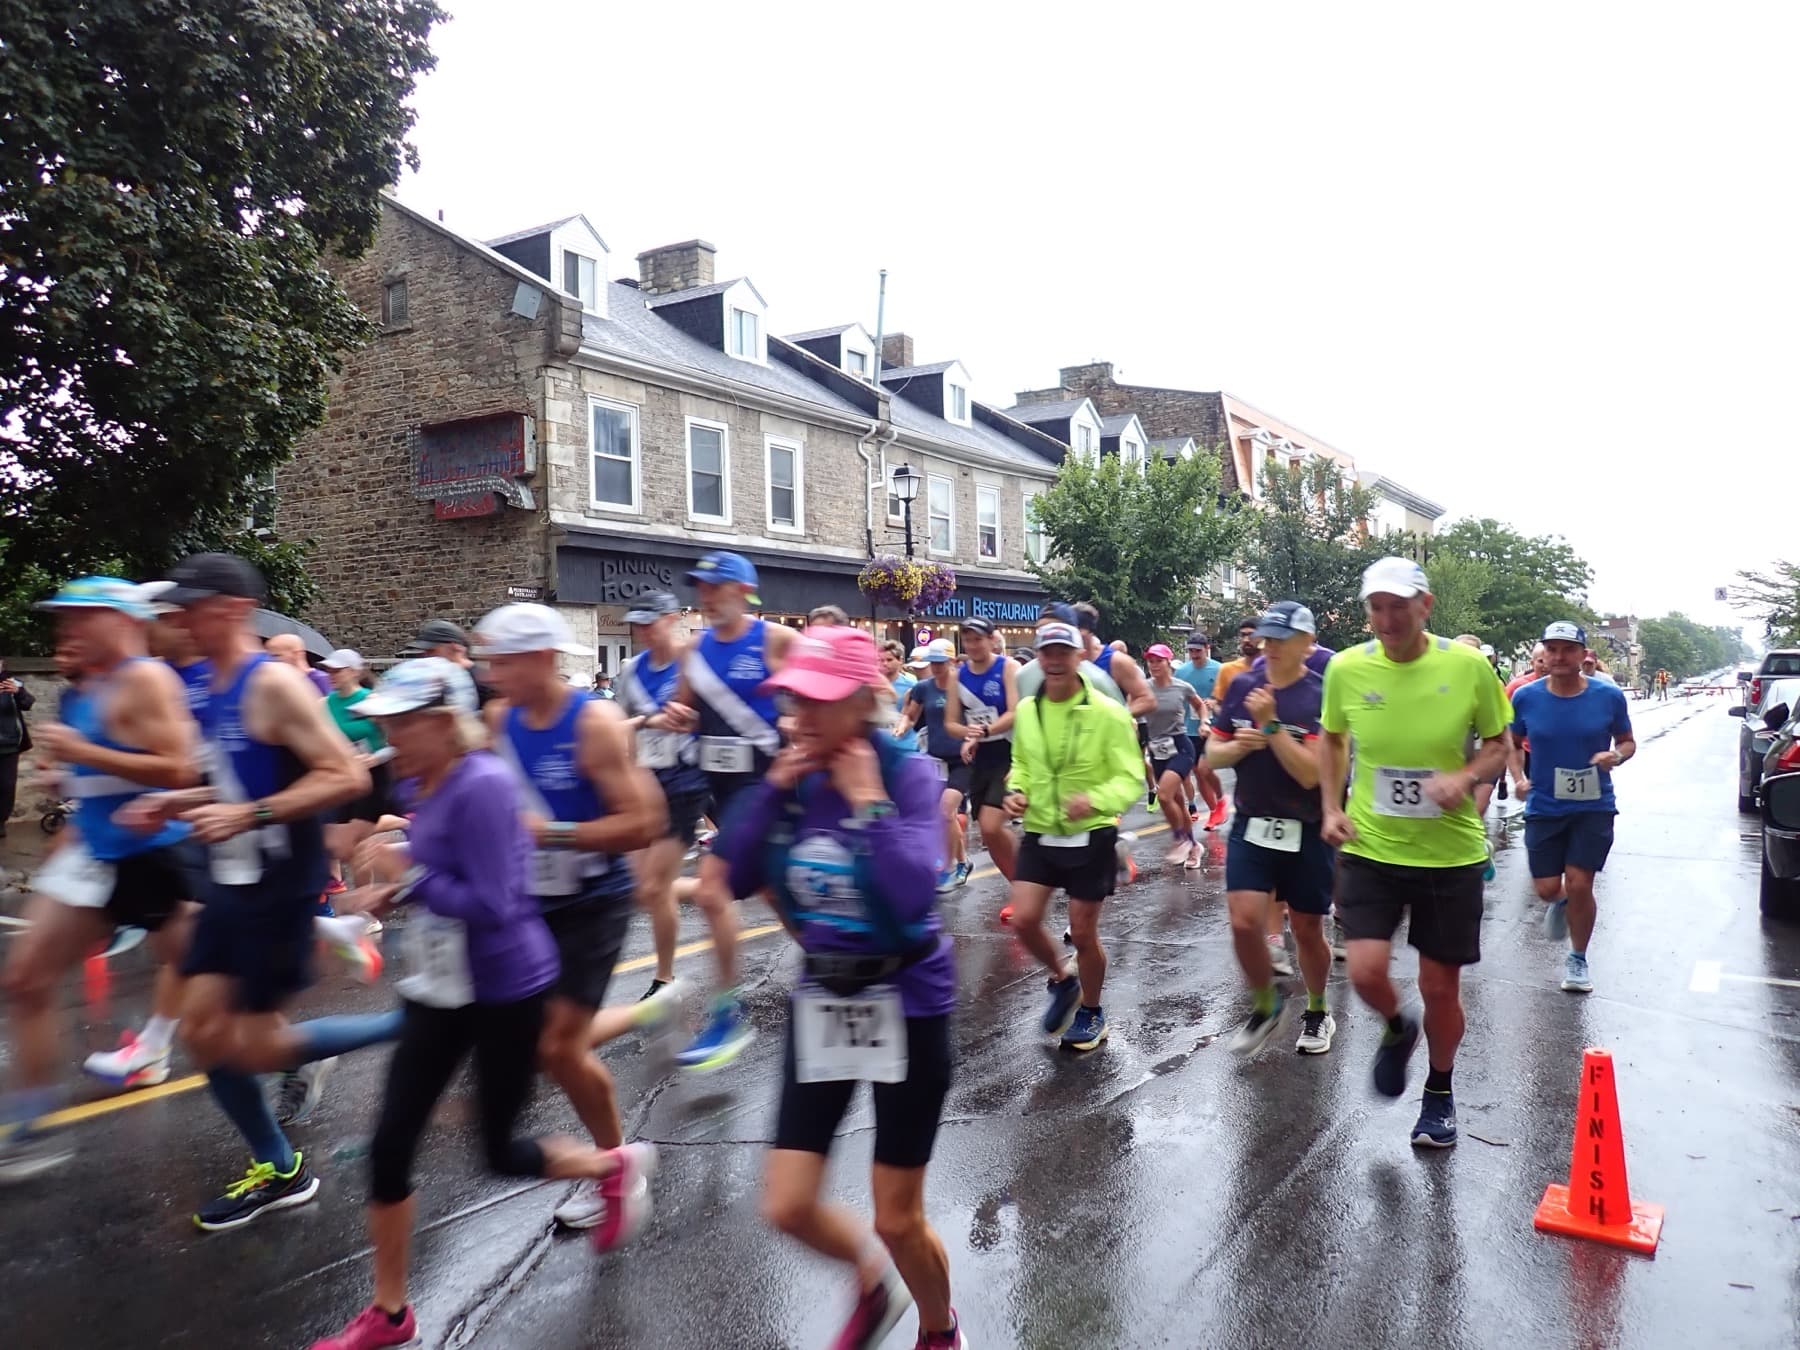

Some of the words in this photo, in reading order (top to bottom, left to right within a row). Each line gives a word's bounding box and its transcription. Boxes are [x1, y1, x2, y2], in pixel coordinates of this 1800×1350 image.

[601, 559, 673, 587] DINING
[601, 581, 662, 603] ROO
[972, 597, 1040, 621] RESTAURANT
[1392, 780, 1421, 805] 83
[1566, 777, 1585, 794] 31
[1263, 818, 1285, 840] 76
[816, 1004, 888, 1048] 762
[1588, 1065, 1605, 1225] FINISH
